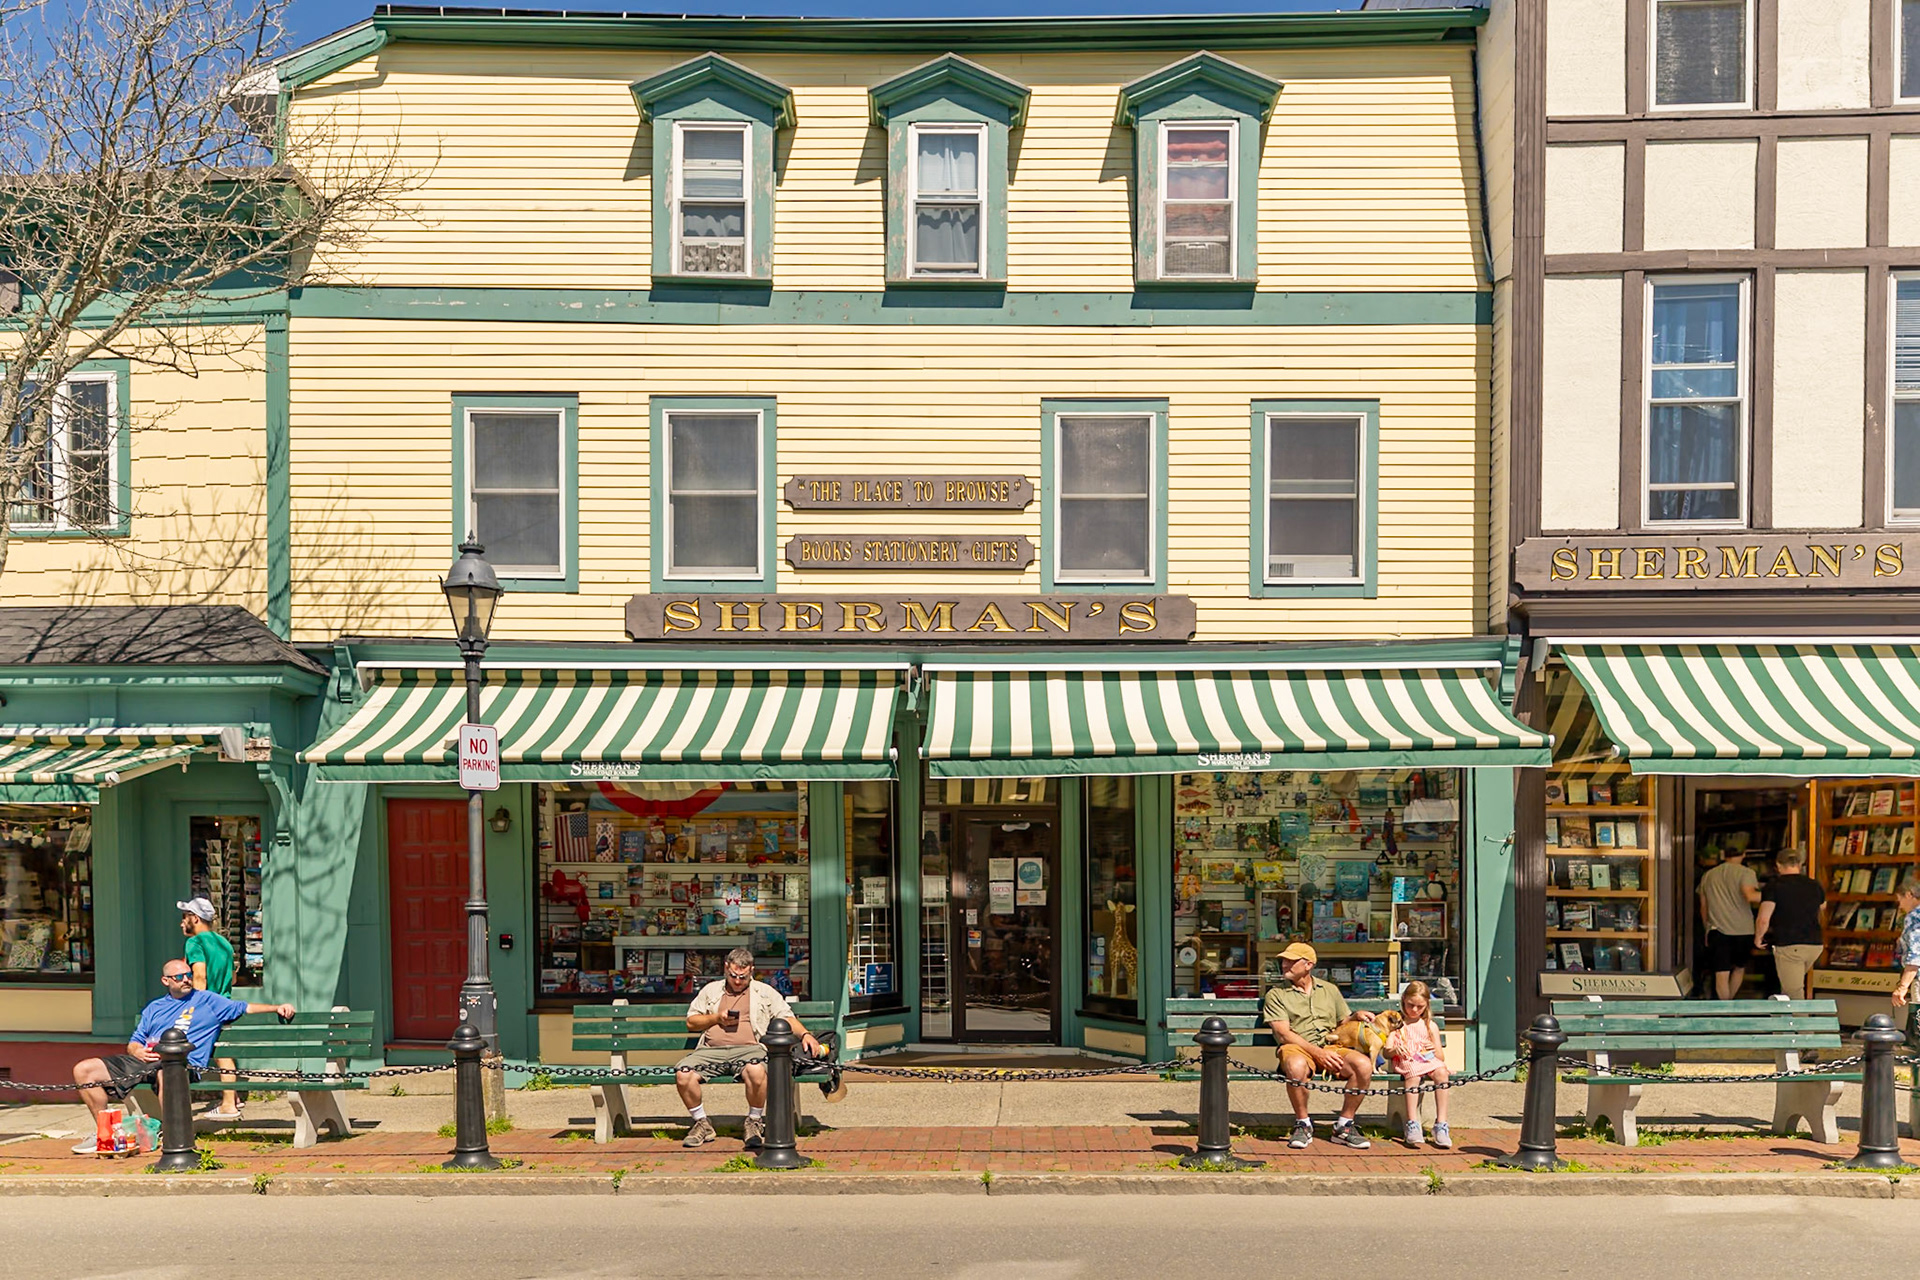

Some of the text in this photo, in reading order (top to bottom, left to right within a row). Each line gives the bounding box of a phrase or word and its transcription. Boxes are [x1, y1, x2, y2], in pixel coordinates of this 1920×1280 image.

[853, 480, 903, 502] PLACE
[914, 480, 935, 502] TO
[801, 541, 1019, 562] BOOKS STATIONERY GIFTS
[1551, 542, 1904, 582] SHERMAN'S
[663, 597, 1158, 635] SHERMAN'S
[469, 737, 488, 755] NO
[462, 758, 496, 772] PARKING
